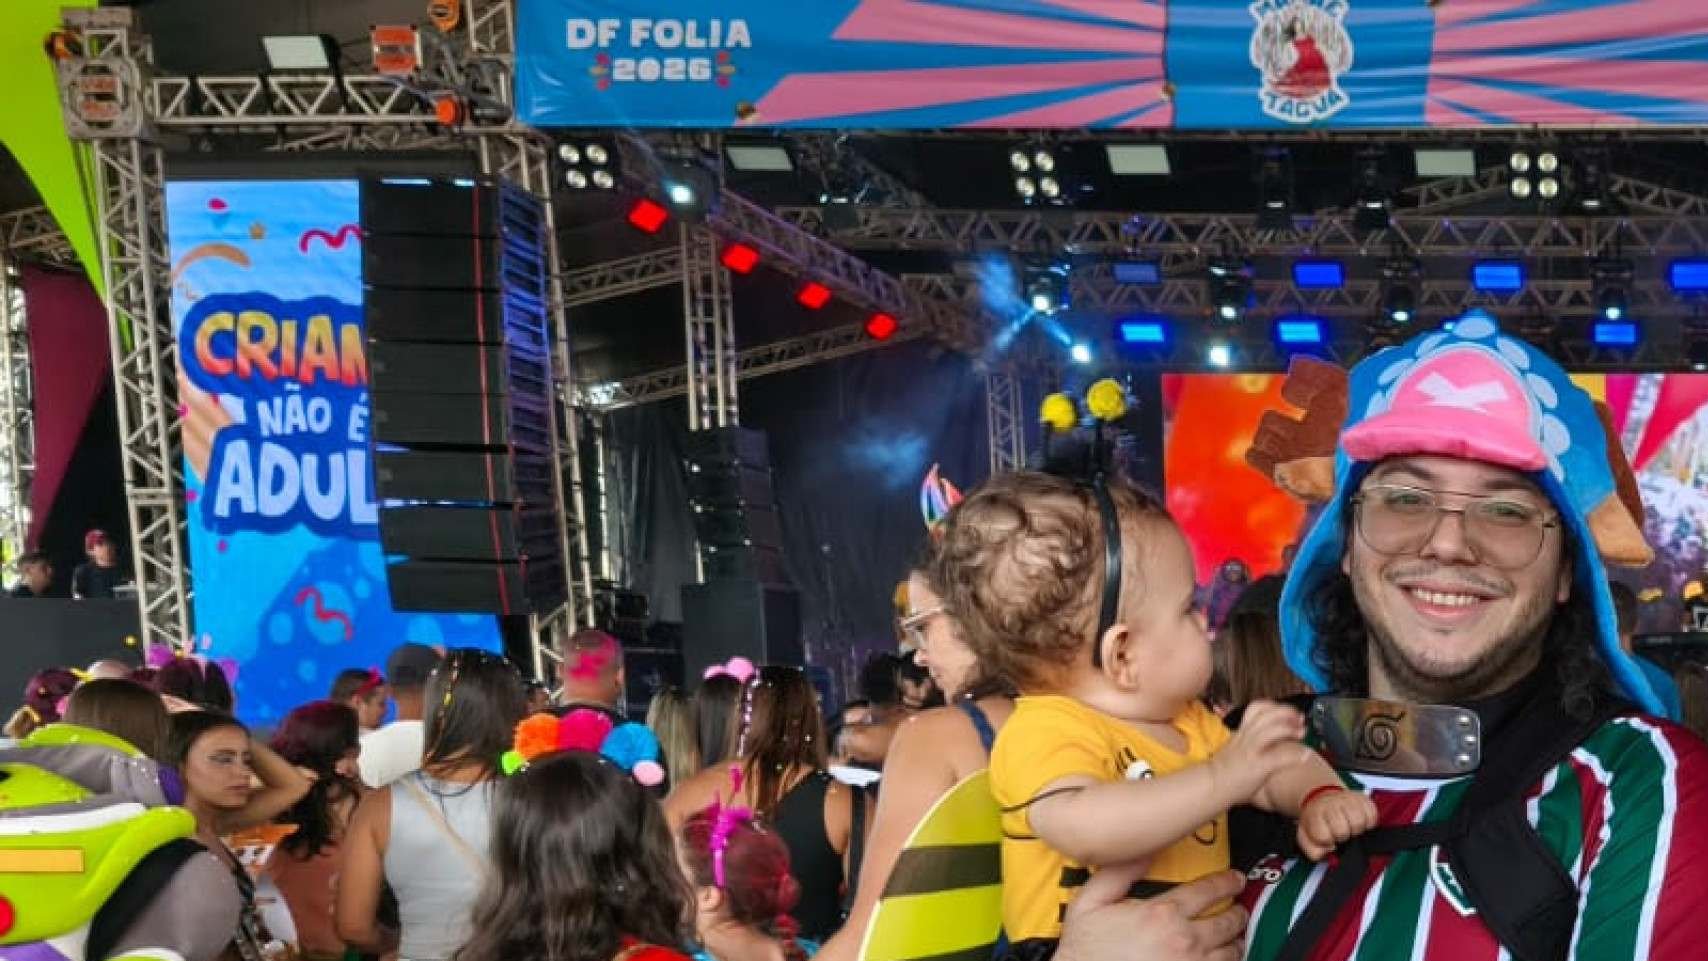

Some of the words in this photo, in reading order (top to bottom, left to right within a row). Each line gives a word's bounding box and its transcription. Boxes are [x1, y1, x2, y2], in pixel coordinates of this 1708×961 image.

[566, 18, 620, 49] DF
[630, 18, 752, 48] FOLIA
[612, 57, 712, 82] 2026
[256, 382, 332, 437] NÃO
[348, 394, 368, 441] É
